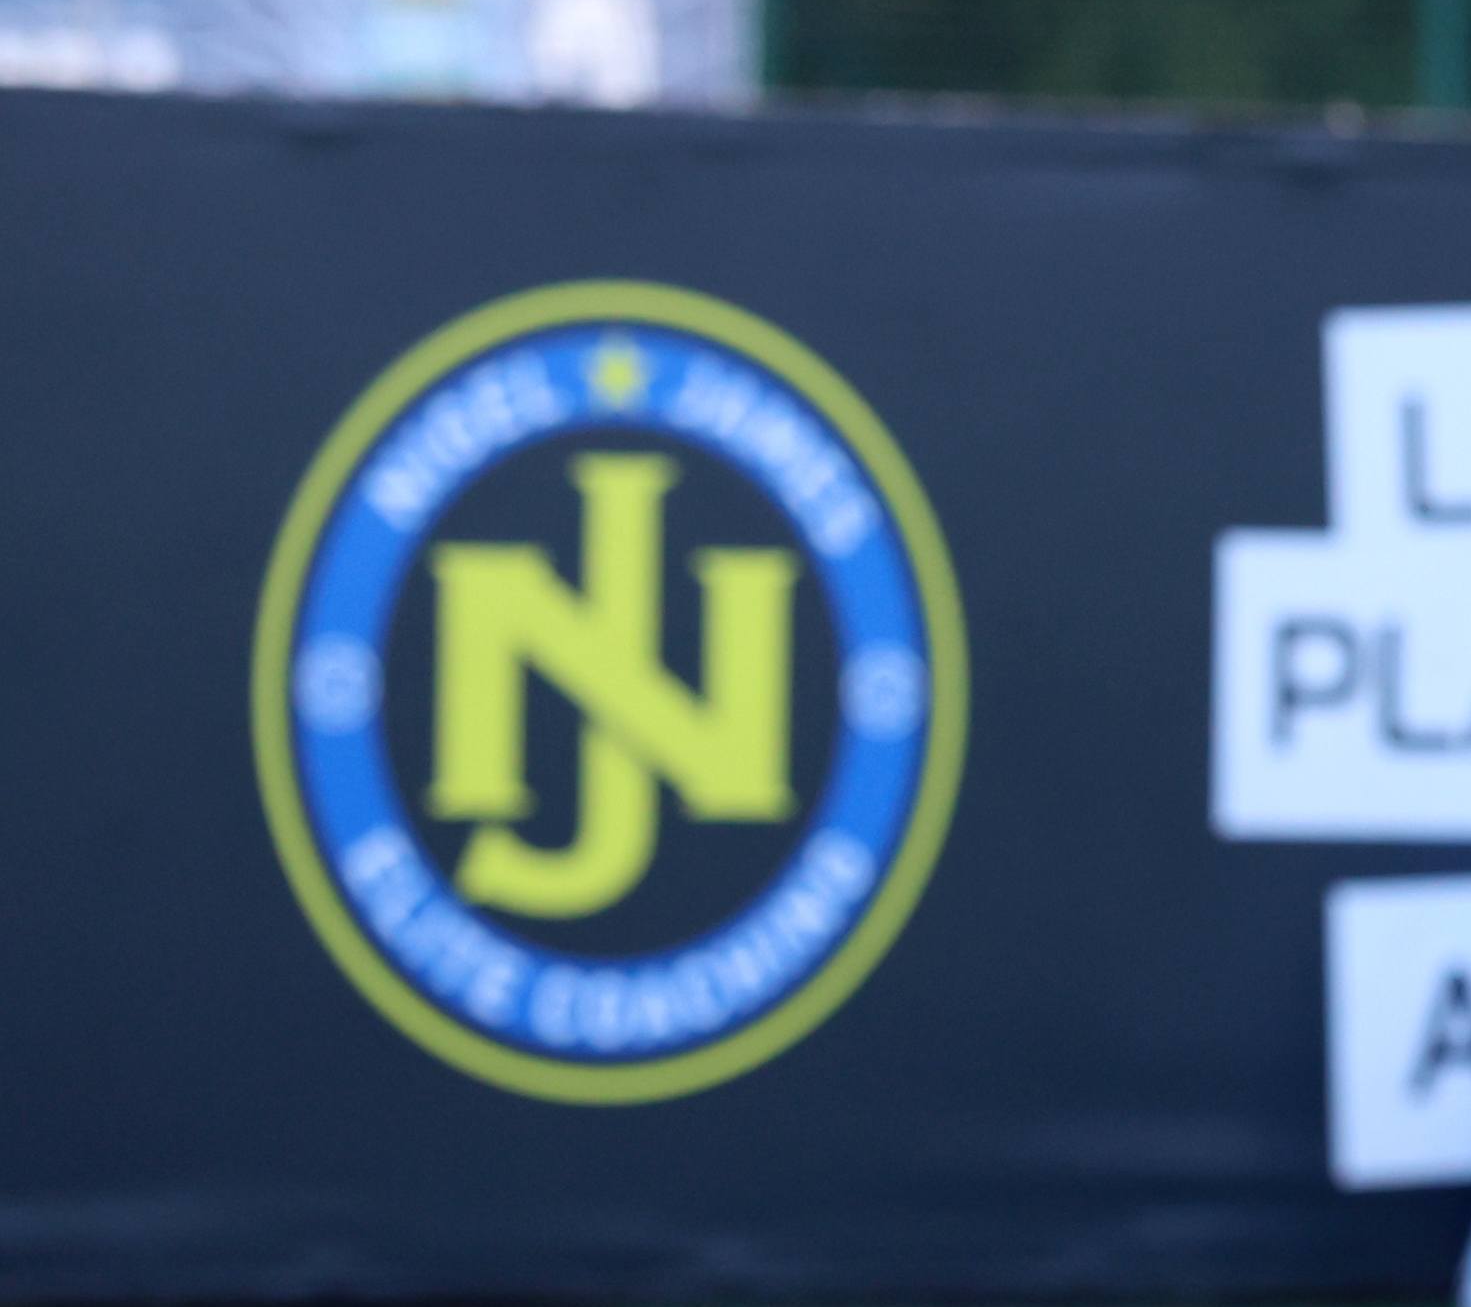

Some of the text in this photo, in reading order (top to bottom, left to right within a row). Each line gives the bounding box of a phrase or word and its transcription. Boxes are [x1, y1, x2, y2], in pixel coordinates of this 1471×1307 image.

[365, 349, 880, 560] NIGEL JAMES
[341, 824, 877, 1051] ELITE COACHING
